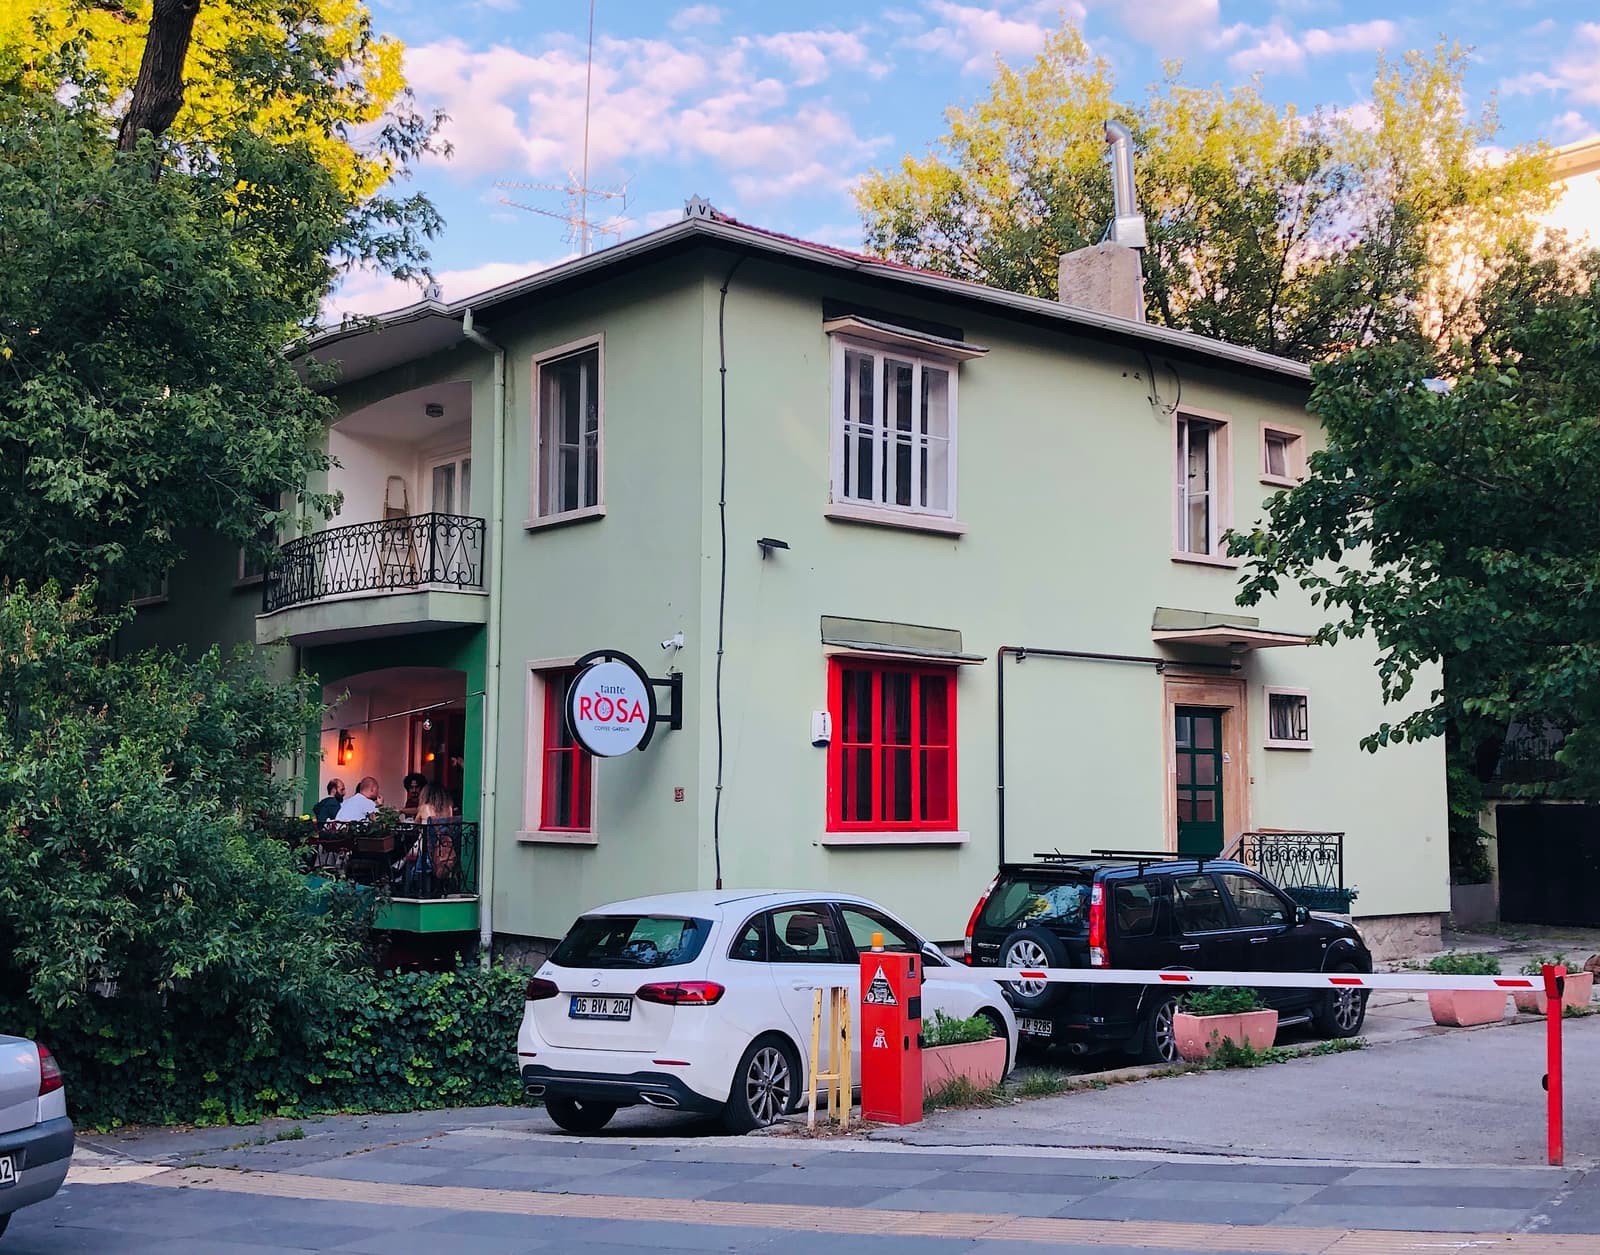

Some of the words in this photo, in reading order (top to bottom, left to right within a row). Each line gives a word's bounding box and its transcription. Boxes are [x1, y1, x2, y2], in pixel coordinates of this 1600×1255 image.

[600, 684, 626, 695] tante
[576, 998, 587, 1013] 06
[591, 999, 608, 1014] BVA
[613, 1000, 629, 1014] 204
[1033, 1020, 1051, 1033] 9285
